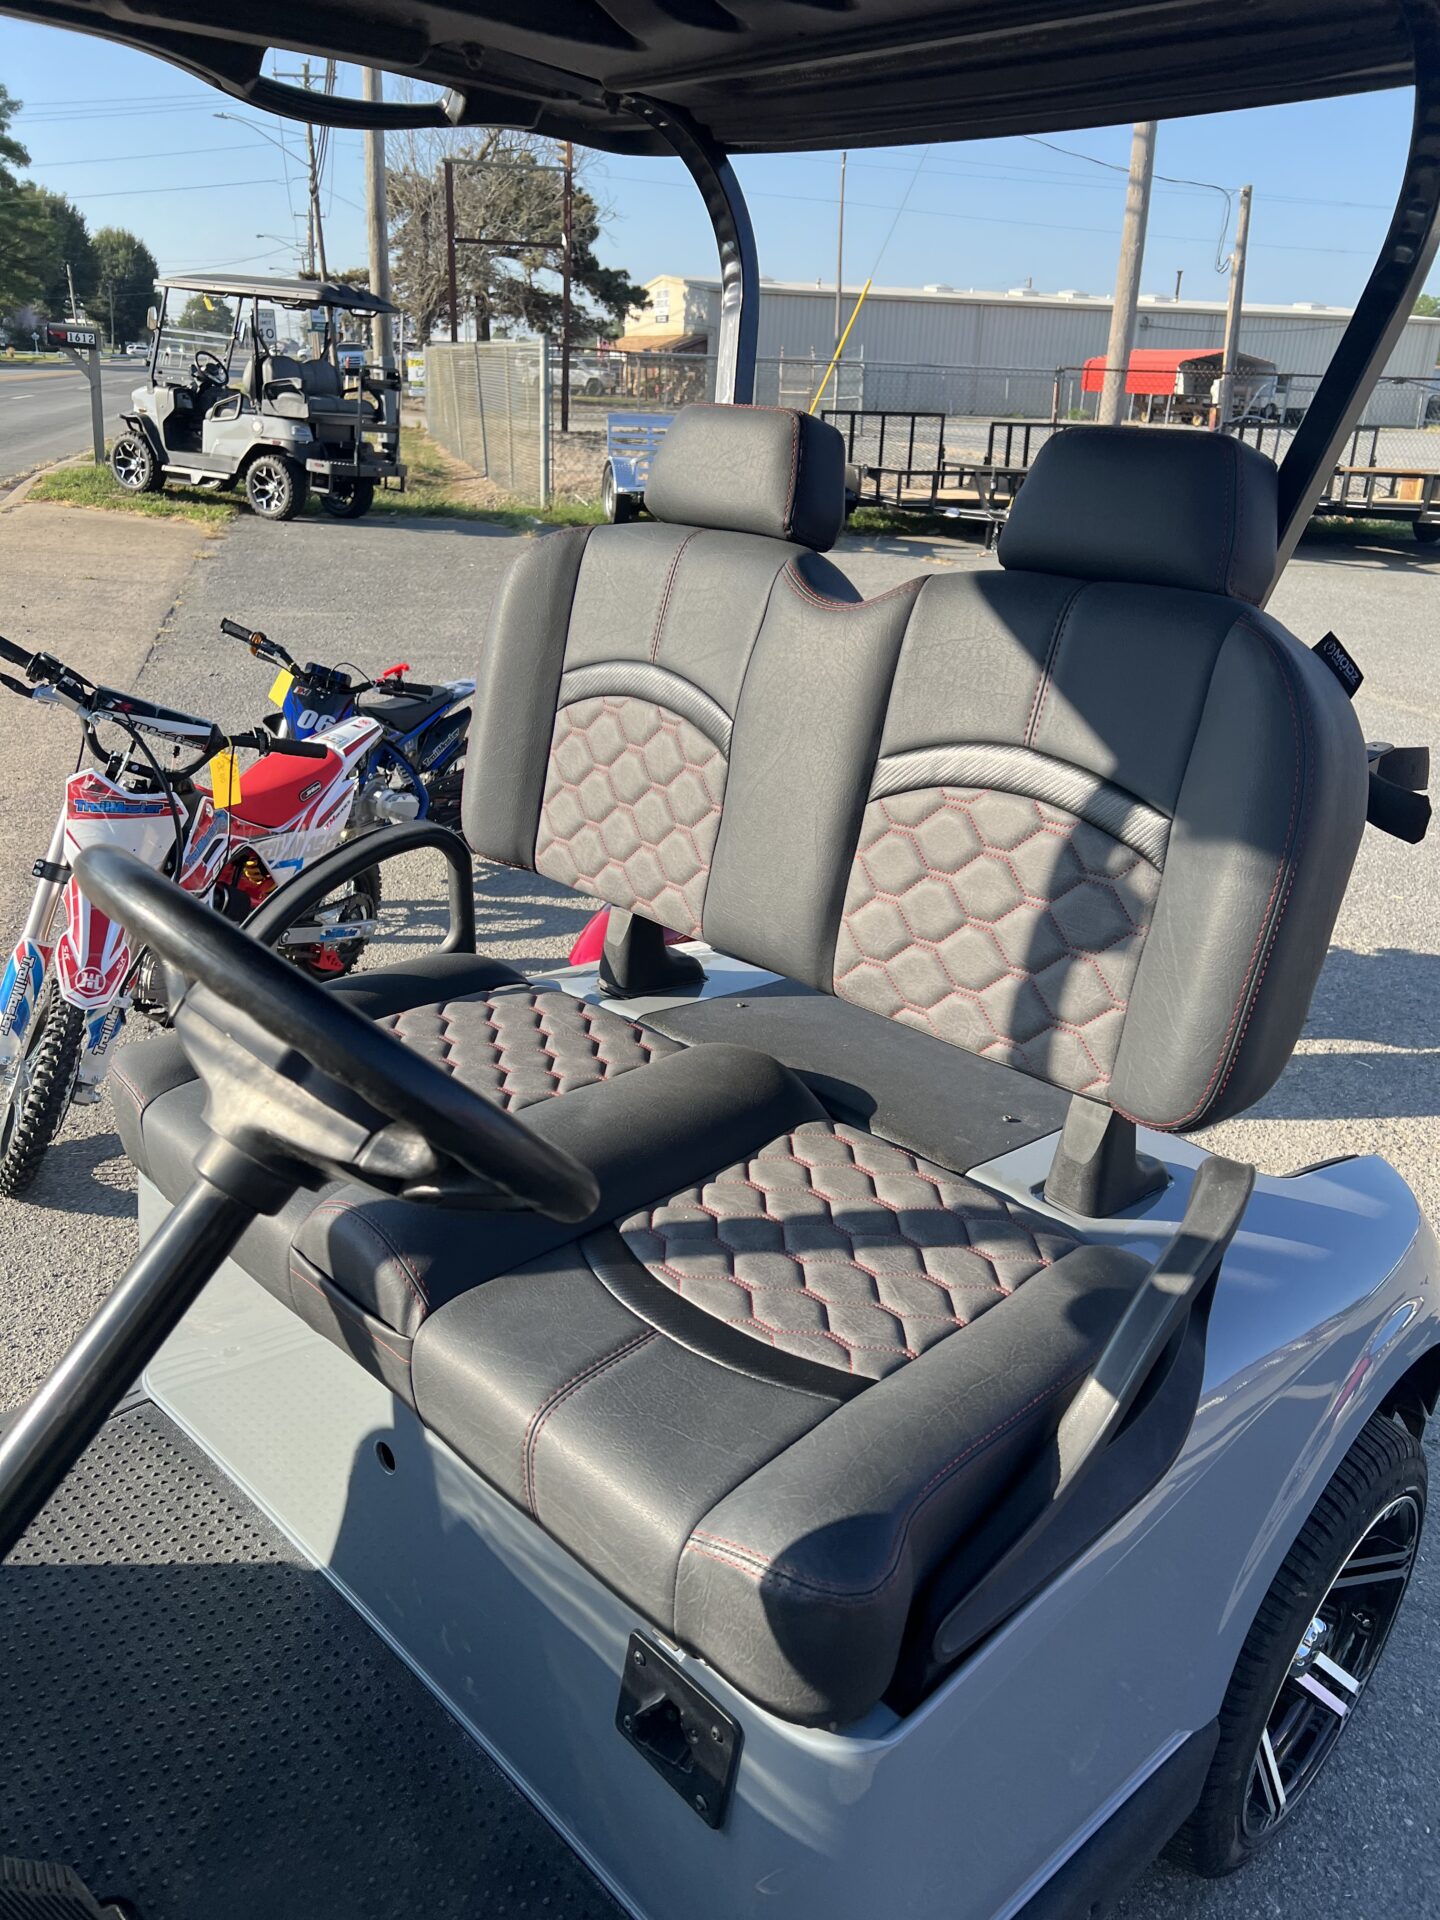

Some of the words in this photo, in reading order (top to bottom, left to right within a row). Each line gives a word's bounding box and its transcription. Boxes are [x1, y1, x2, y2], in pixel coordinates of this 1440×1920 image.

[69, 332, 94, 344] 1612
[1333, 648, 1360, 683] MODZ
[297, 709, 337, 733] 06
[74, 799, 165, 815] TrailMaster
[1, 956, 37, 1037] TrailMaster
[92, 1004, 121, 1057] TrailMa
